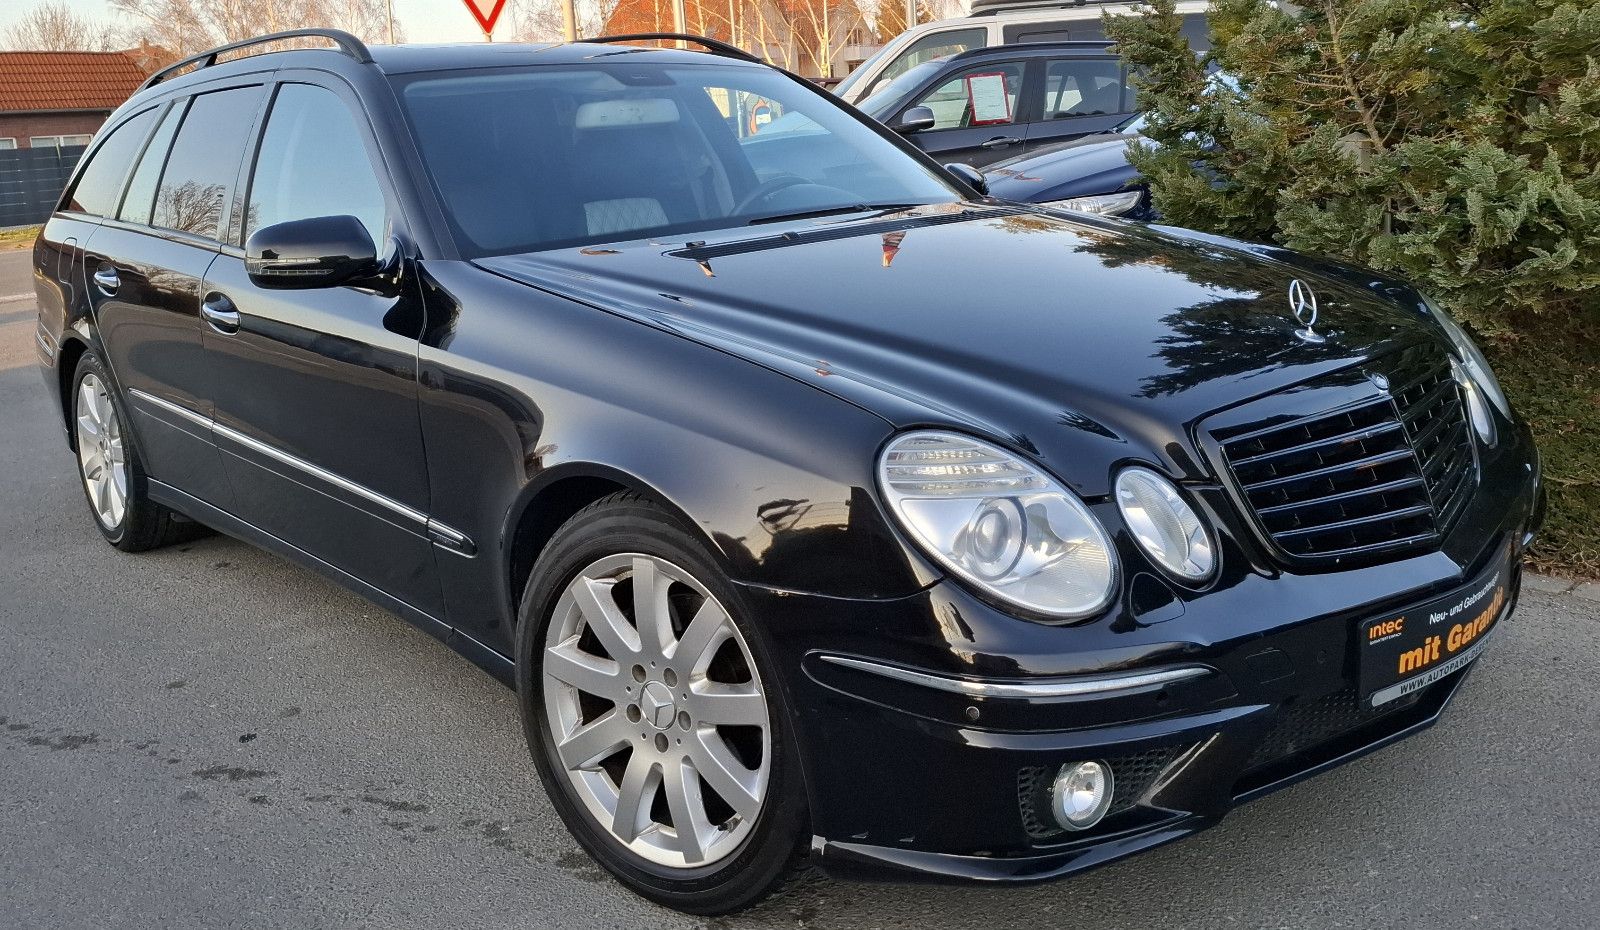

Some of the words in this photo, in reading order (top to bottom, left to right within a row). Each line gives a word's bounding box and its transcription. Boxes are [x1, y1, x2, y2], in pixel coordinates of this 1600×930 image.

[1398, 634, 1441, 674] mit
[1446, 586, 1504, 652] Garantie
[1429, 611, 1448, 625] Neu-
[1449, 600, 1464, 616] und
